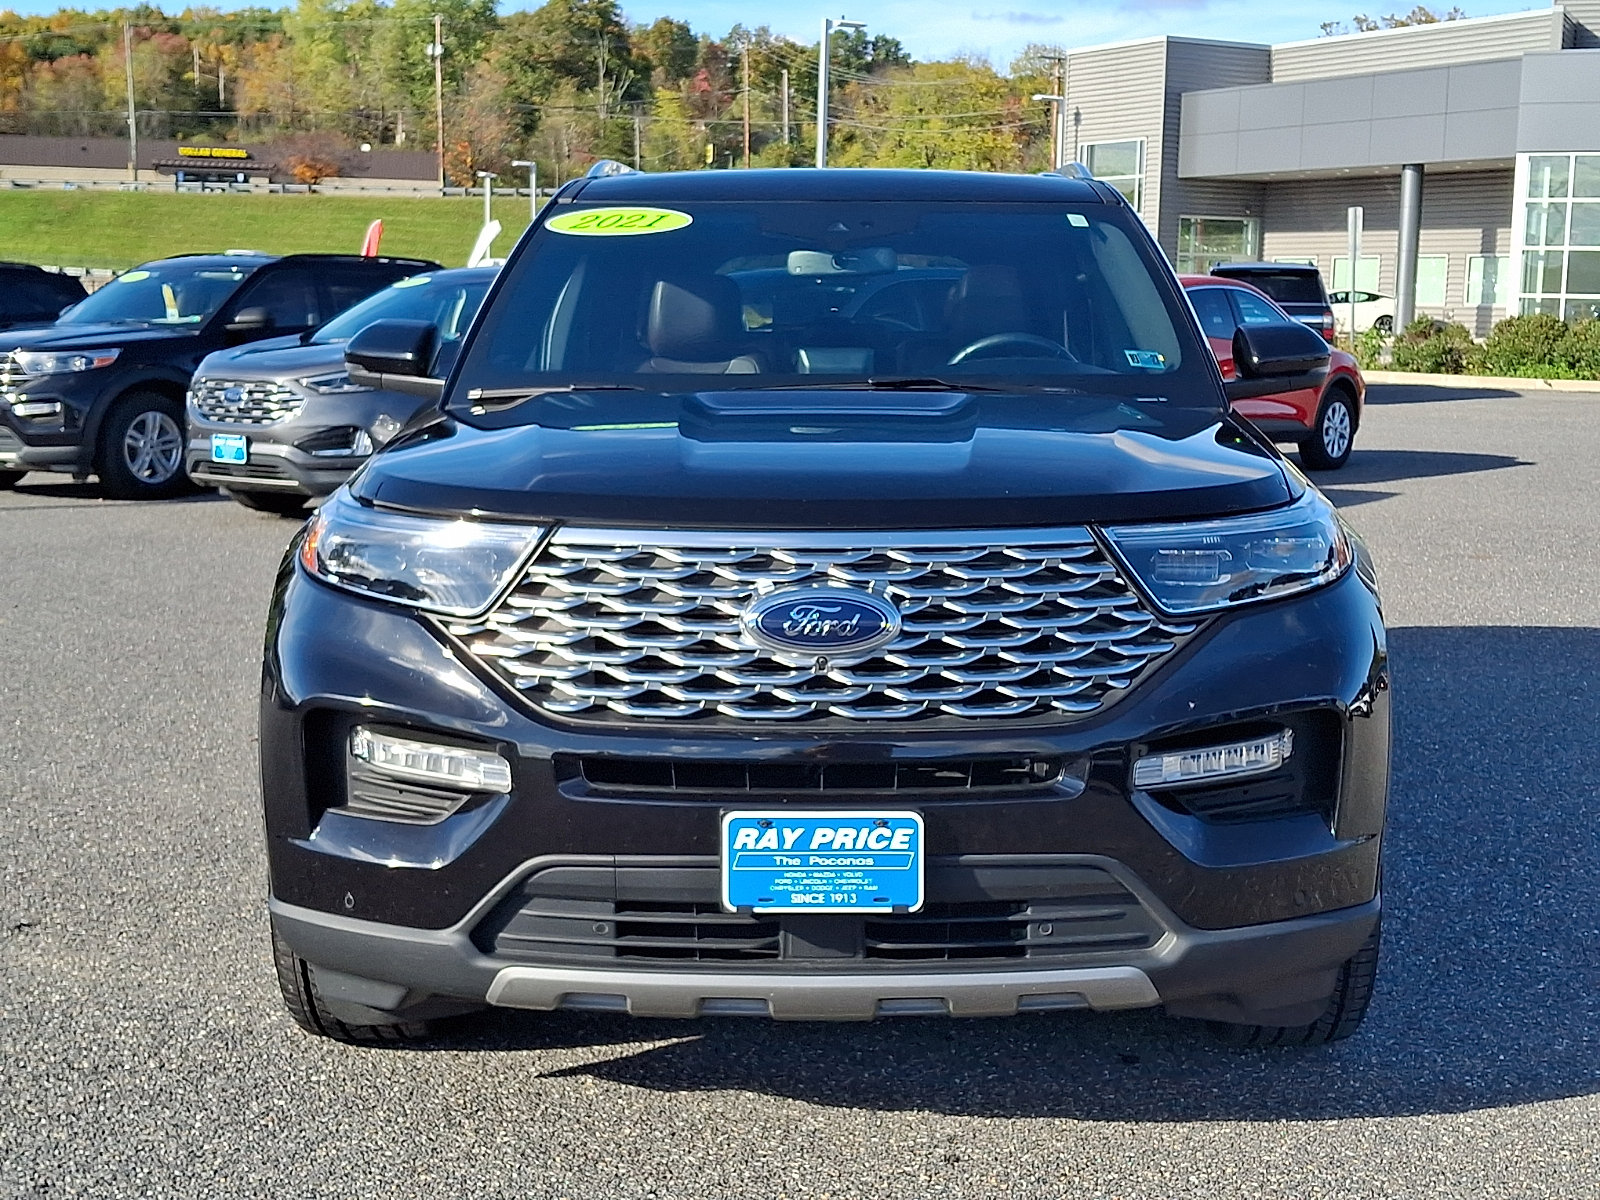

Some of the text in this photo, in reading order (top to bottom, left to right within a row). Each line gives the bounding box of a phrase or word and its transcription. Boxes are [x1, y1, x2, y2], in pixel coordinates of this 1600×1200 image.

[568, 213, 670, 230] 2021
[782, 604, 861, 637] Ford
[732, 827, 915, 850] RAY PRICE
[773, 856, 875, 866] The Poconos
[790, 893, 857, 904] SINCE 1913
